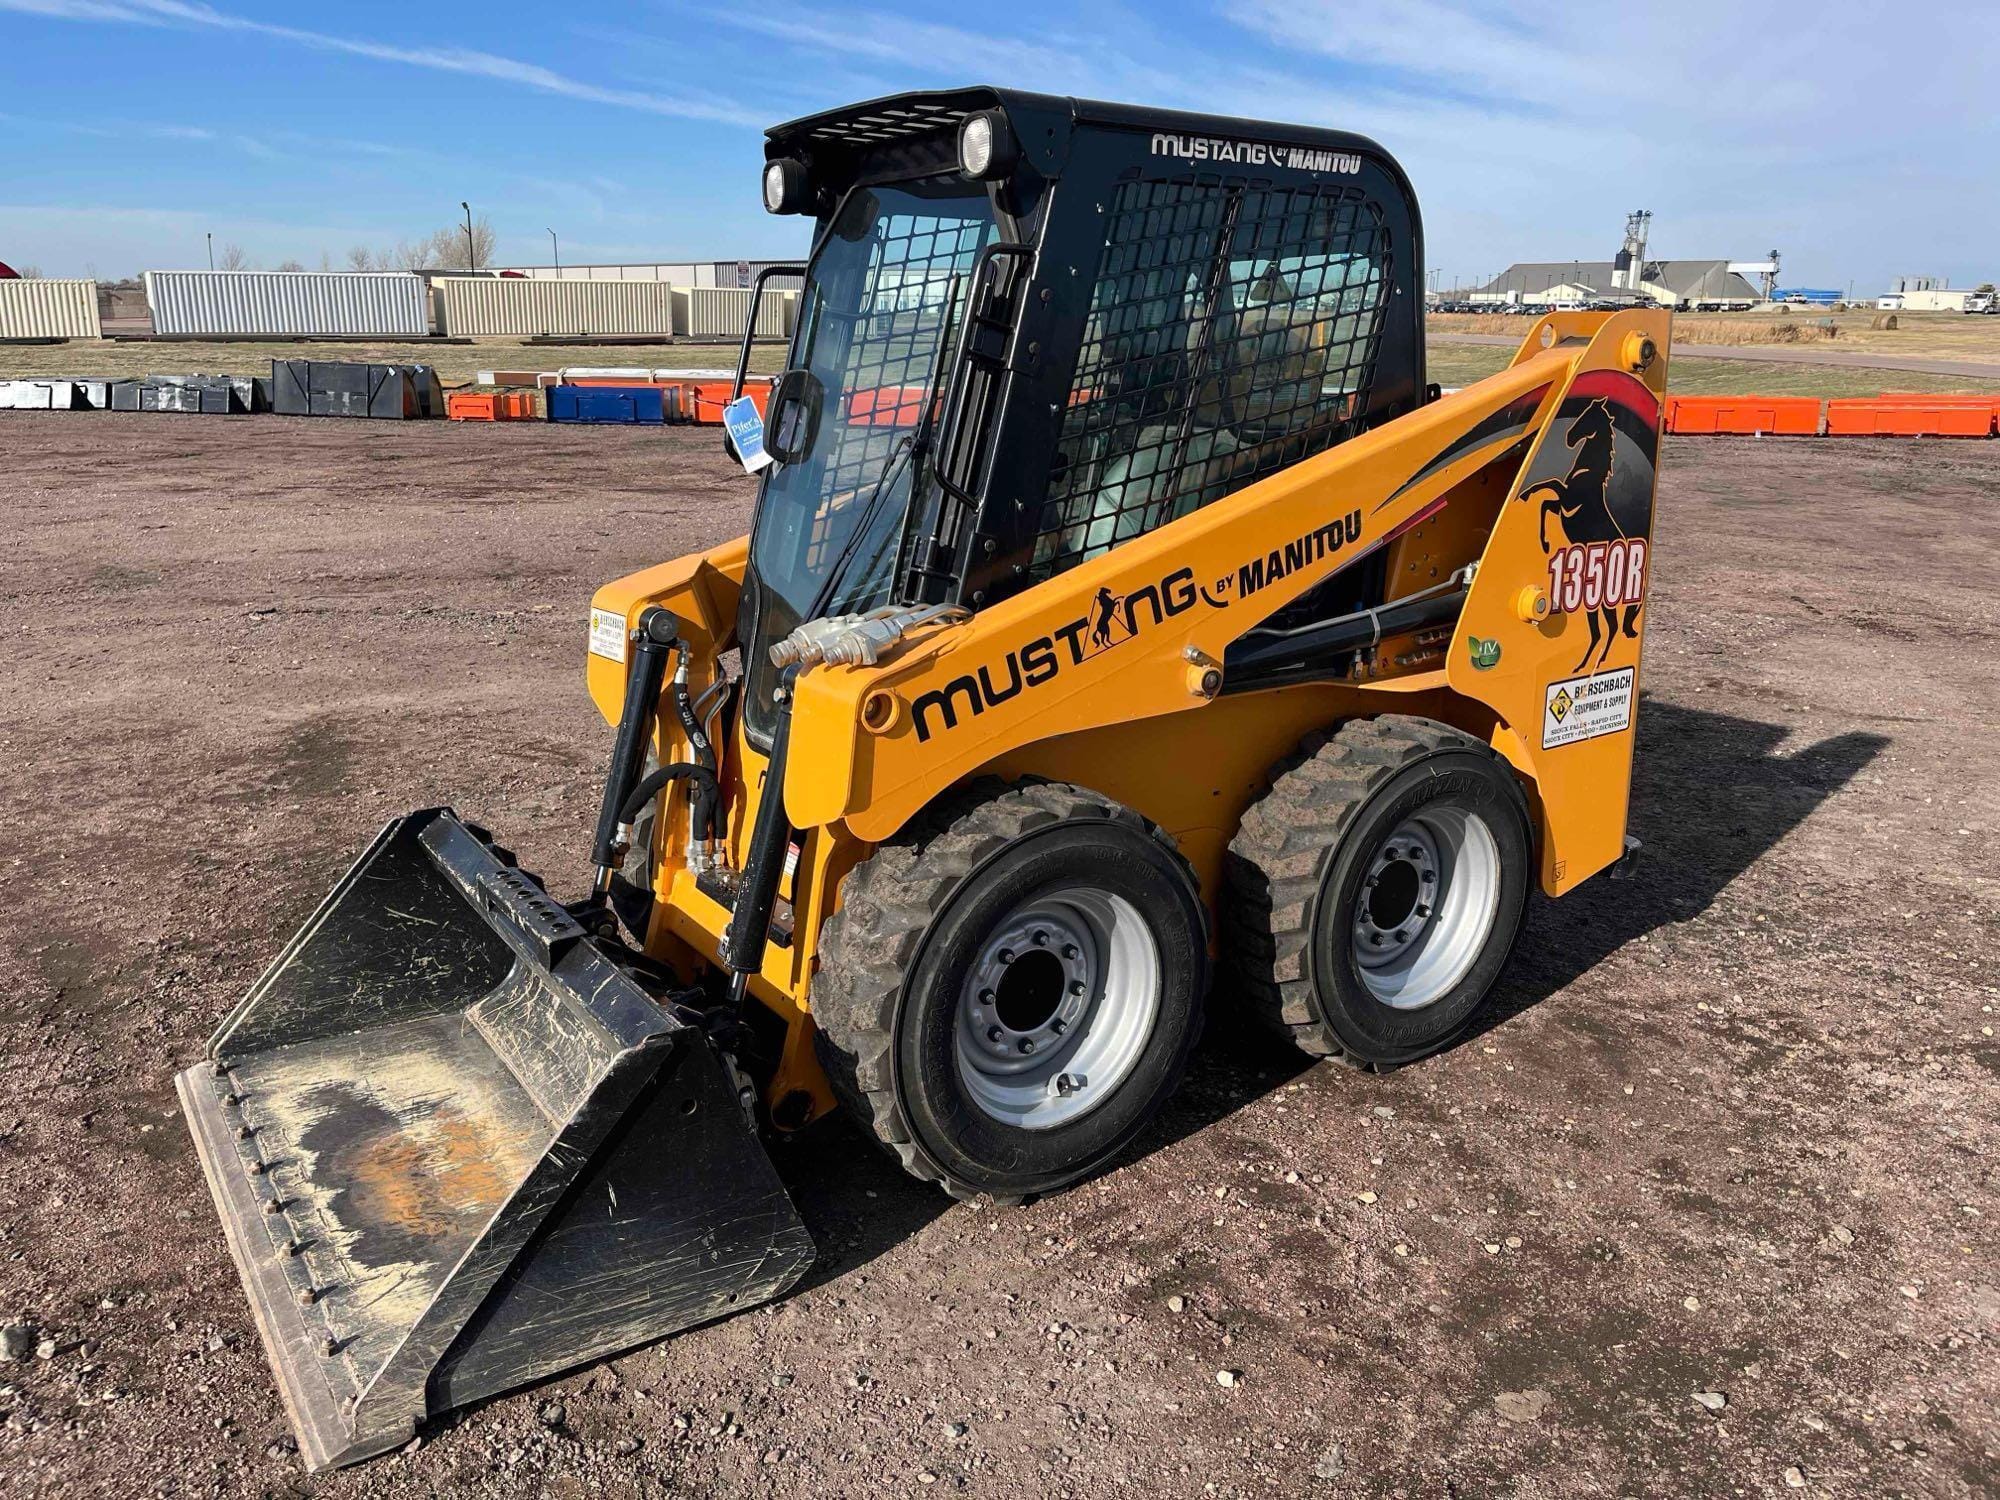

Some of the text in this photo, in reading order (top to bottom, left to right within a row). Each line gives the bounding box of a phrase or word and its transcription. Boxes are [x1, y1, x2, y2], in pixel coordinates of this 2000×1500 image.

[1152, 133, 1362, 175] MUSTANG BY MANITOU
[1216, 573, 1235, 595] BY
[1238, 508, 1362, 600] MANITOU
[1549, 540, 1648, 613] 1350R
[1574, 675, 1631, 699] BIRSCHBACH
[1574, 699, 1603, 715] EQUIPMENT
[1608, 694, 1628, 707] SUPPLY
